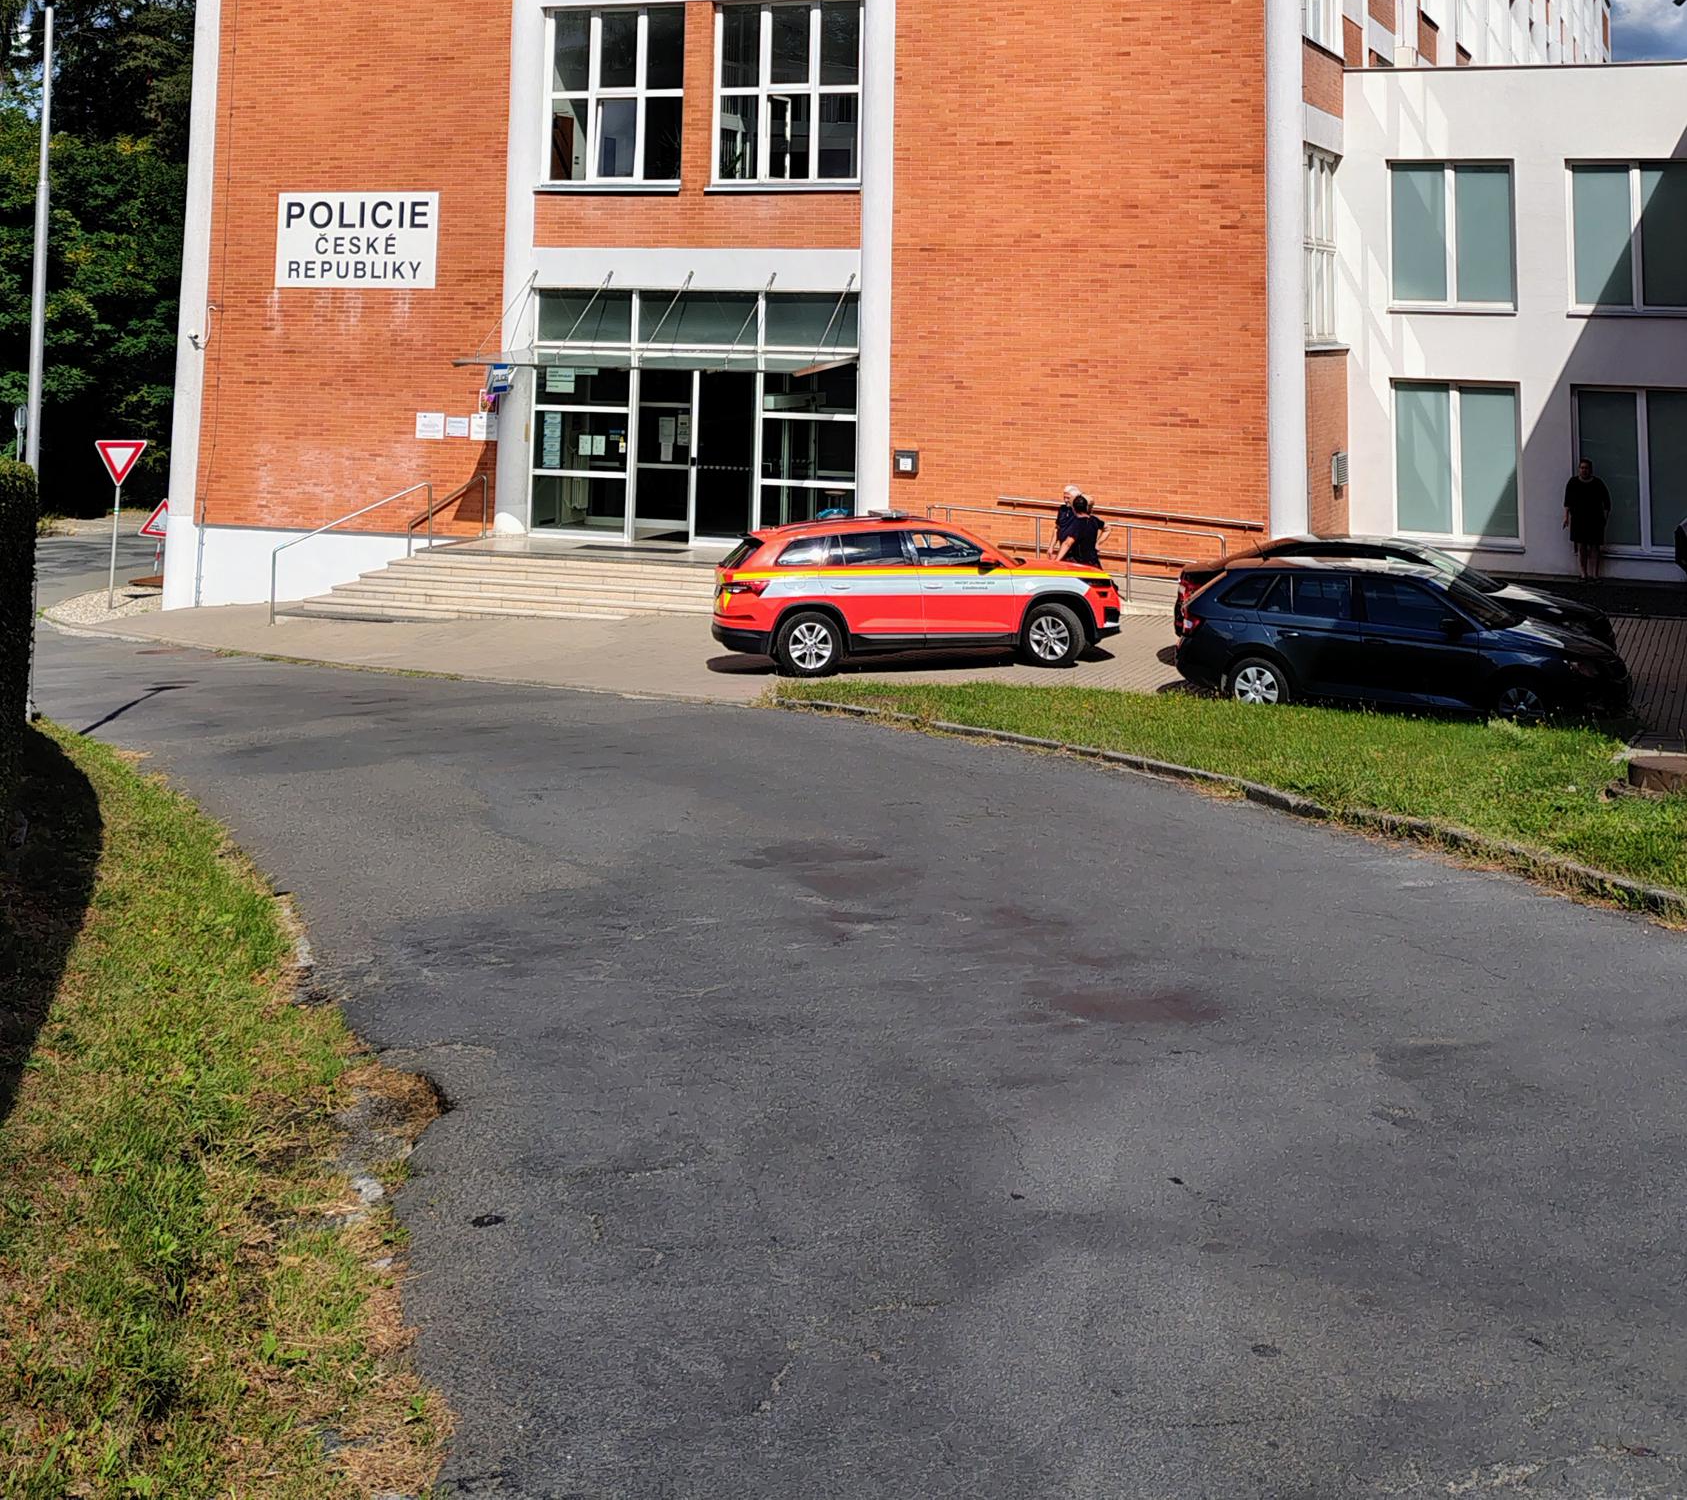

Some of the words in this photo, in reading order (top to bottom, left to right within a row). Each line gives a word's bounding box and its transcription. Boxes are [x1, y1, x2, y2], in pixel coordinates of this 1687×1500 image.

[286, 201, 429, 229] POLICIE
[315, 233, 397, 255] ČESKÉ
[288, 261, 422, 280] REPUBLIKY
